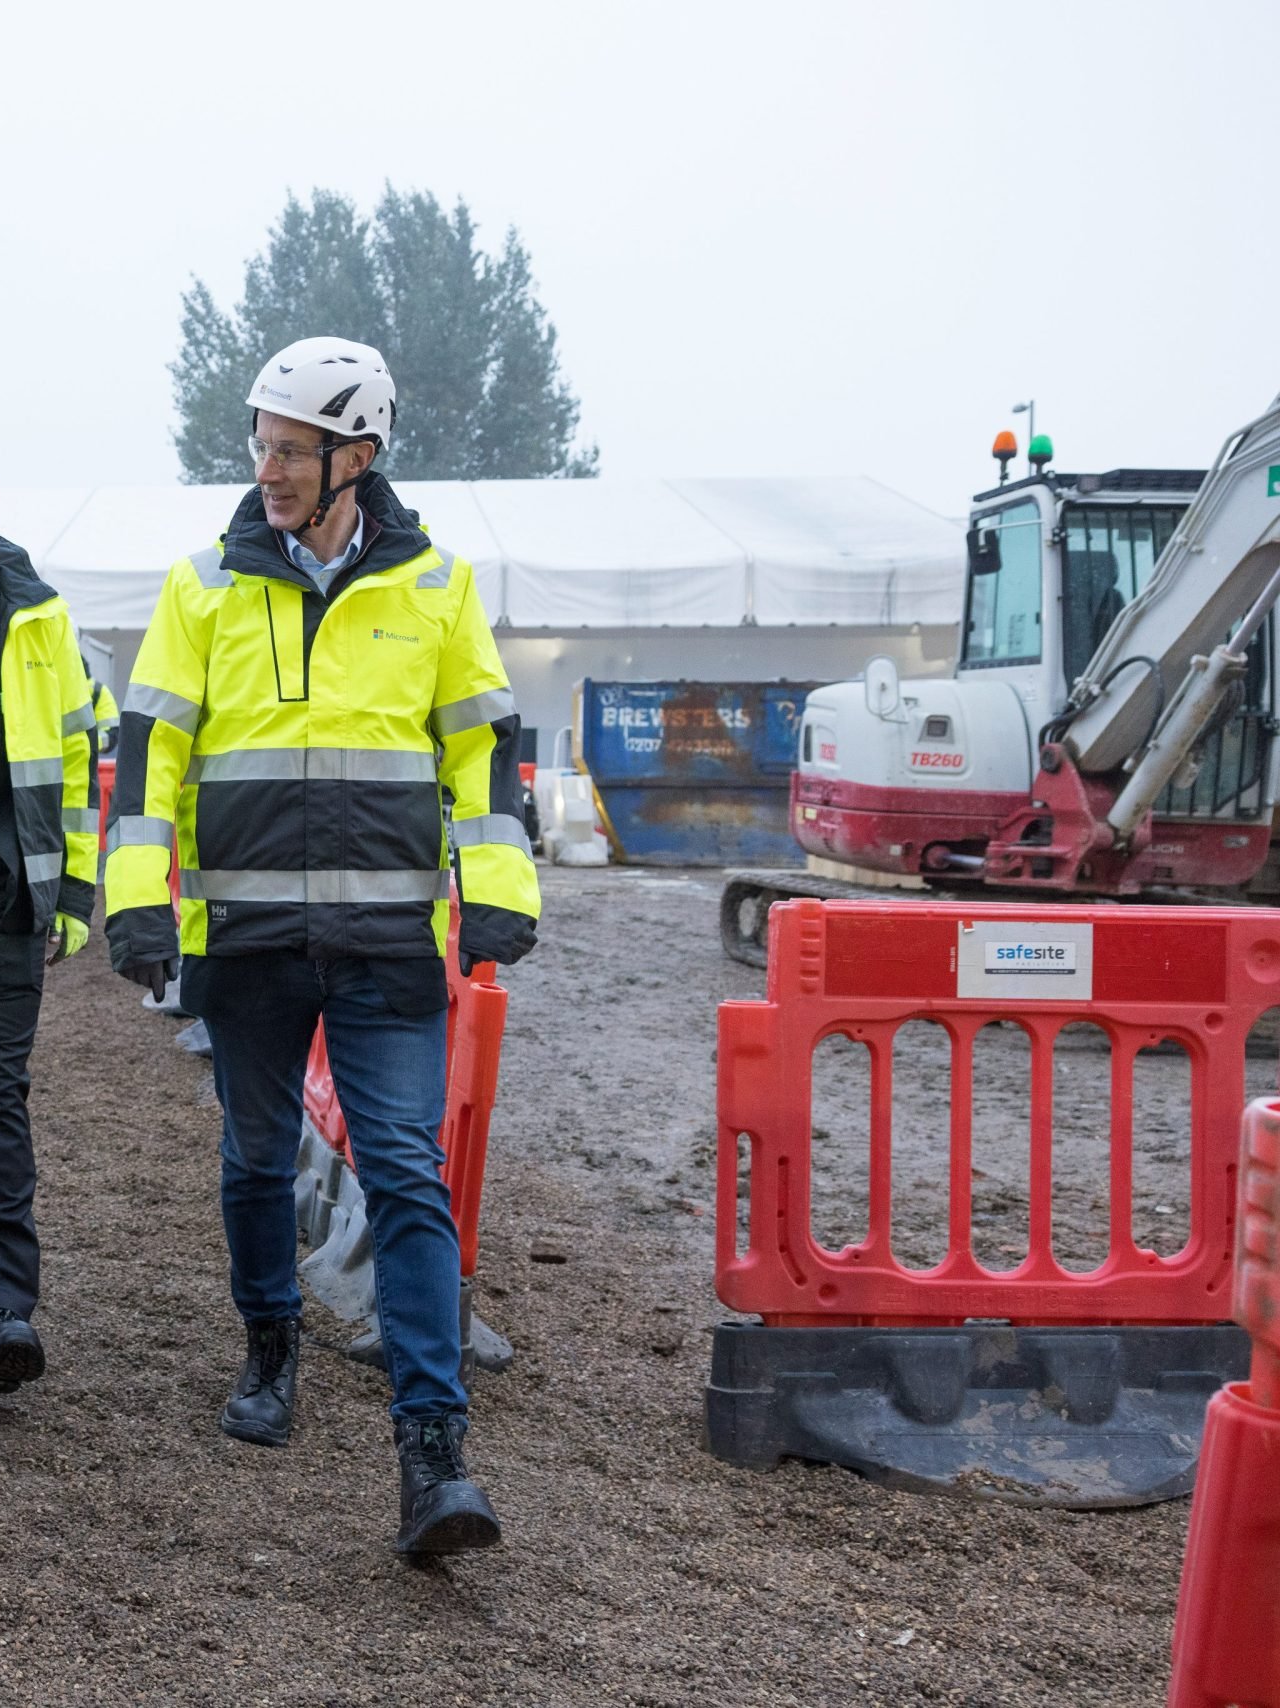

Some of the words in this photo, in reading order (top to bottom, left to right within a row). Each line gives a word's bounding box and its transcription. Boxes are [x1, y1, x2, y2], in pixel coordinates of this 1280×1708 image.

[385, 632, 419, 644] Microsoft
[911, 752, 965, 768] TB260
[211, 904, 227, 917] HH
[997, 944, 1066, 960] safesite
